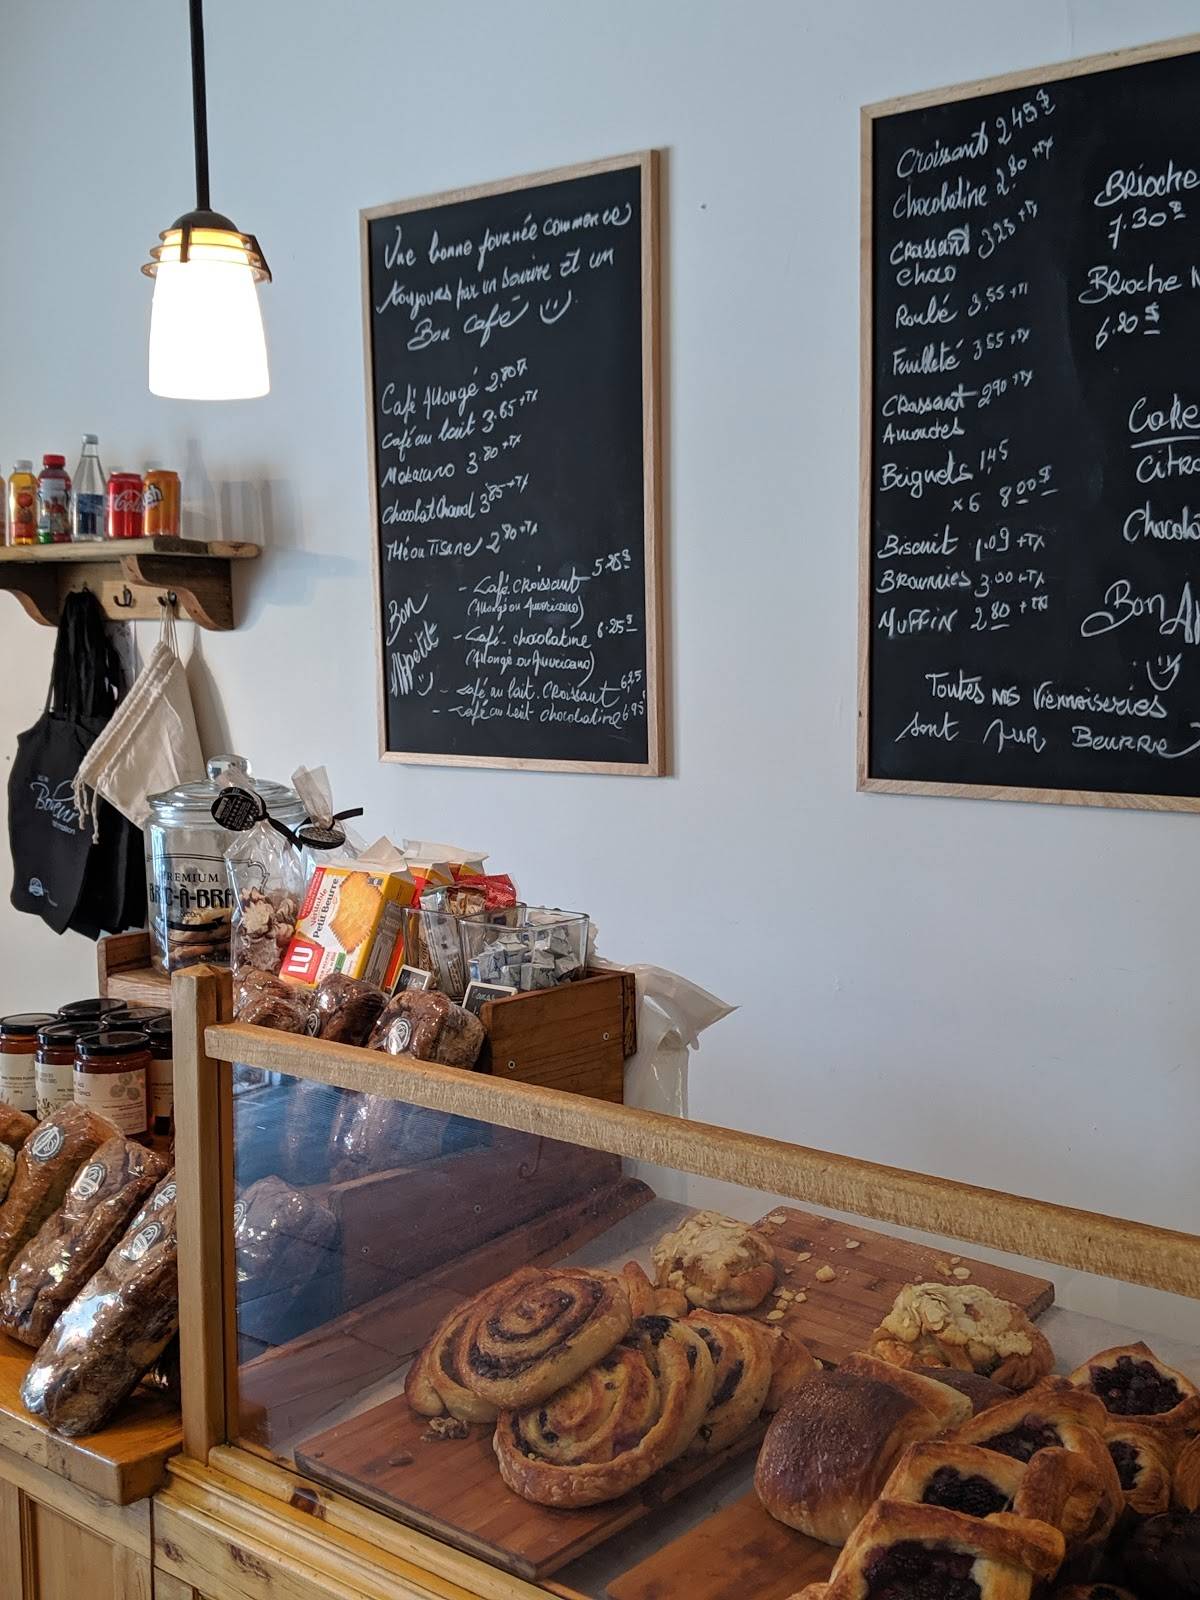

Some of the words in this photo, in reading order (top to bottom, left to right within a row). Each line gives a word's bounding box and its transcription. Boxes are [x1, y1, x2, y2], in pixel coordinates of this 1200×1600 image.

[897, 121, 989, 178] Croissant
[893, 176, 987, 218] Chocolatine
[384, 225, 417, 270] Une
[427, 230, 473, 264] bonne
[542, 202, 632, 238] commence
[456, 276, 478, 310] par
[482, 280, 497, 294] un
[407, 317, 451, 351] Bon
[382, 382, 417, 424] Café
[415, 433, 432, 446] au
[438, 412, 475, 441] lait
[879, 450, 974, 499] Beignets
[877, 524, 959, 559] Biscuit
[386, 594, 428, 646] Bon
[1080, 579, 1165, 638] Bon
[925, 669, 985, 704] Toutes
[895, 712, 960, 743] sont
[160, 872, 219, 883] REMIUM
[312, 914, 327, 939] Petit
[322, 877, 339, 915] Beurre
[287, 946, 313, 973] LU
